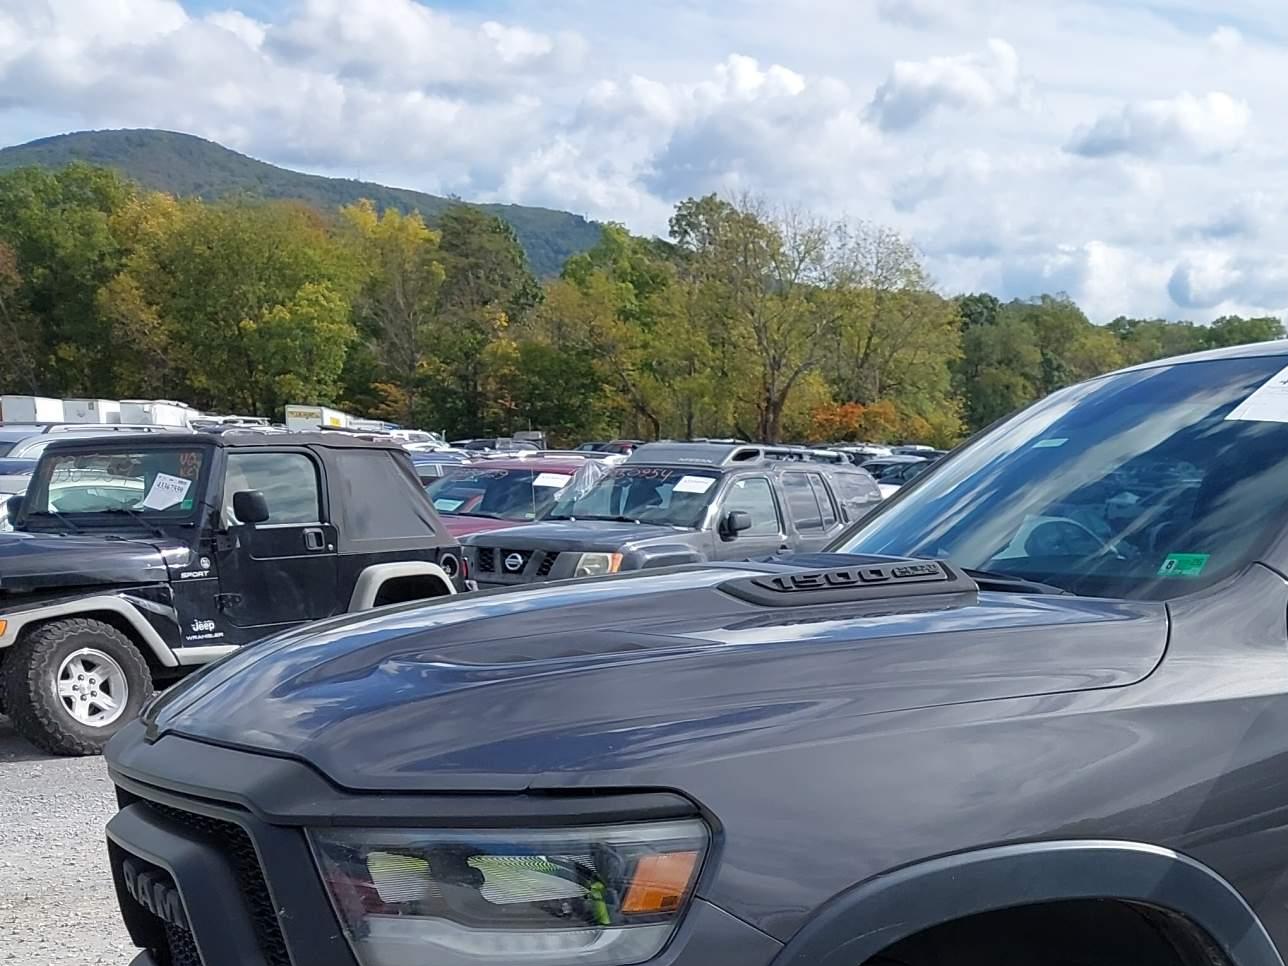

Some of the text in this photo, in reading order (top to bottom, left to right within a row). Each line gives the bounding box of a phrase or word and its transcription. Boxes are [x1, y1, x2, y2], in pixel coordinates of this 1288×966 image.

[181, 570, 210, 579] SPORT
[772, 568, 890, 591] 1500
[191, 619, 215, 632] Jeep
[186, 632, 224, 641] WRANGLER
[123, 859, 187, 929] RAM
